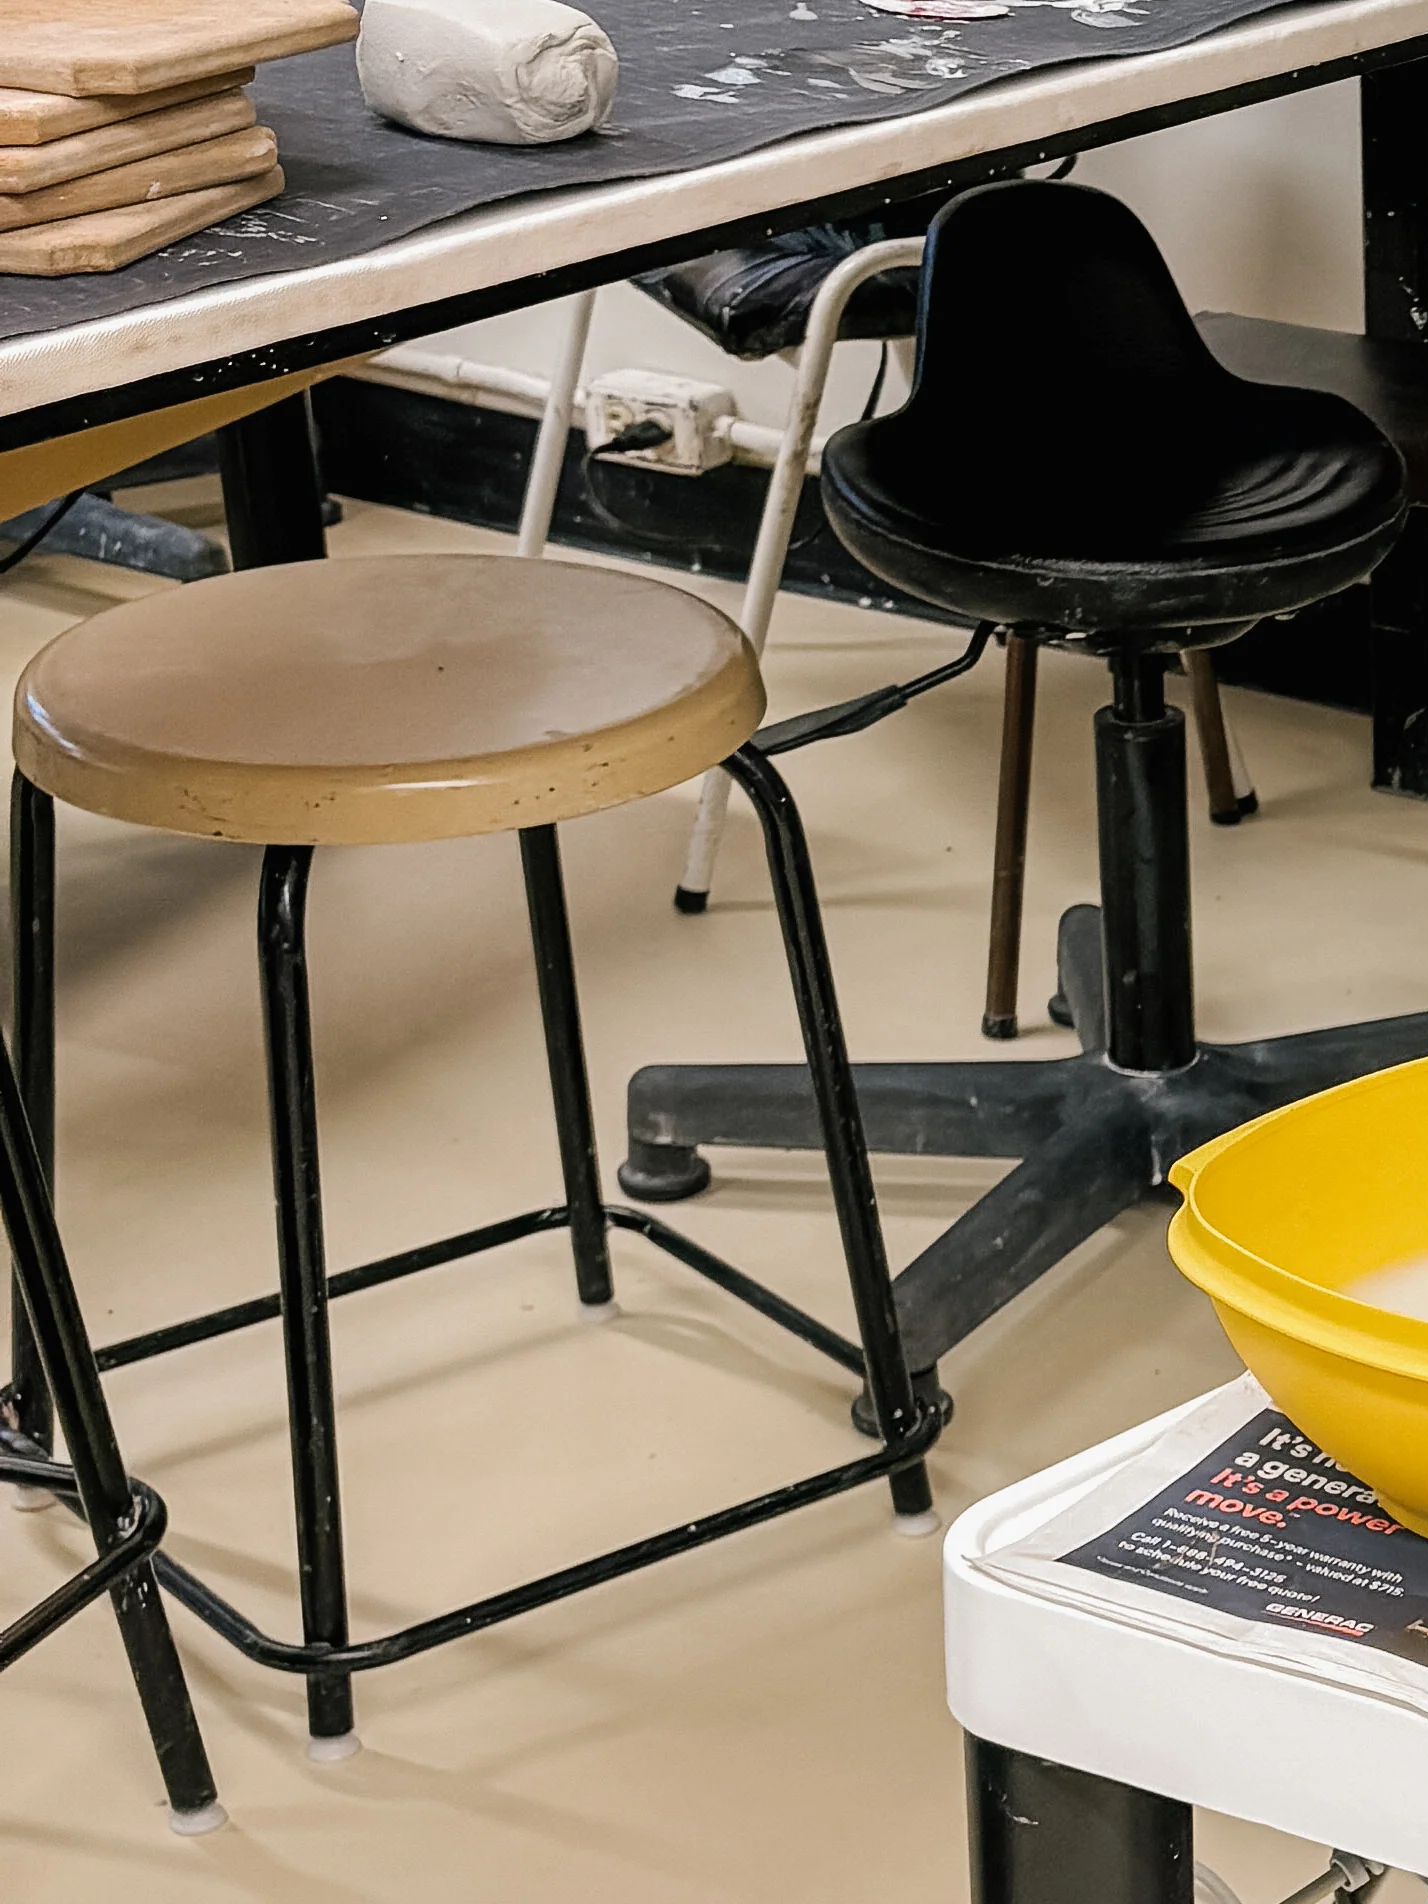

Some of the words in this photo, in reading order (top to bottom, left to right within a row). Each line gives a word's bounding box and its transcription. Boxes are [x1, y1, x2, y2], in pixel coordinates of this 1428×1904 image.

[1258, 1427, 1314, 1459] It's
[1234, 1450, 1260, 1469] a
[1256, 1458, 1388, 1507] genera
[1184, 1489, 1288, 1529] move.
[1209, 1467, 1265, 1495] It's
[1264, 1488, 1290, 1504] a
[1286, 1495, 1405, 1536] power
[1130, 1531, 1162, 1549] Call
[1198, 1565, 1238, 1586] your
[1304, 1563, 1352, 1583] valued
[1309, 1549, 1372, 1576] warranty
[1370, 1567, 1405, 1584] with
[1264, 1602, 1376, 1633] GENERAC
